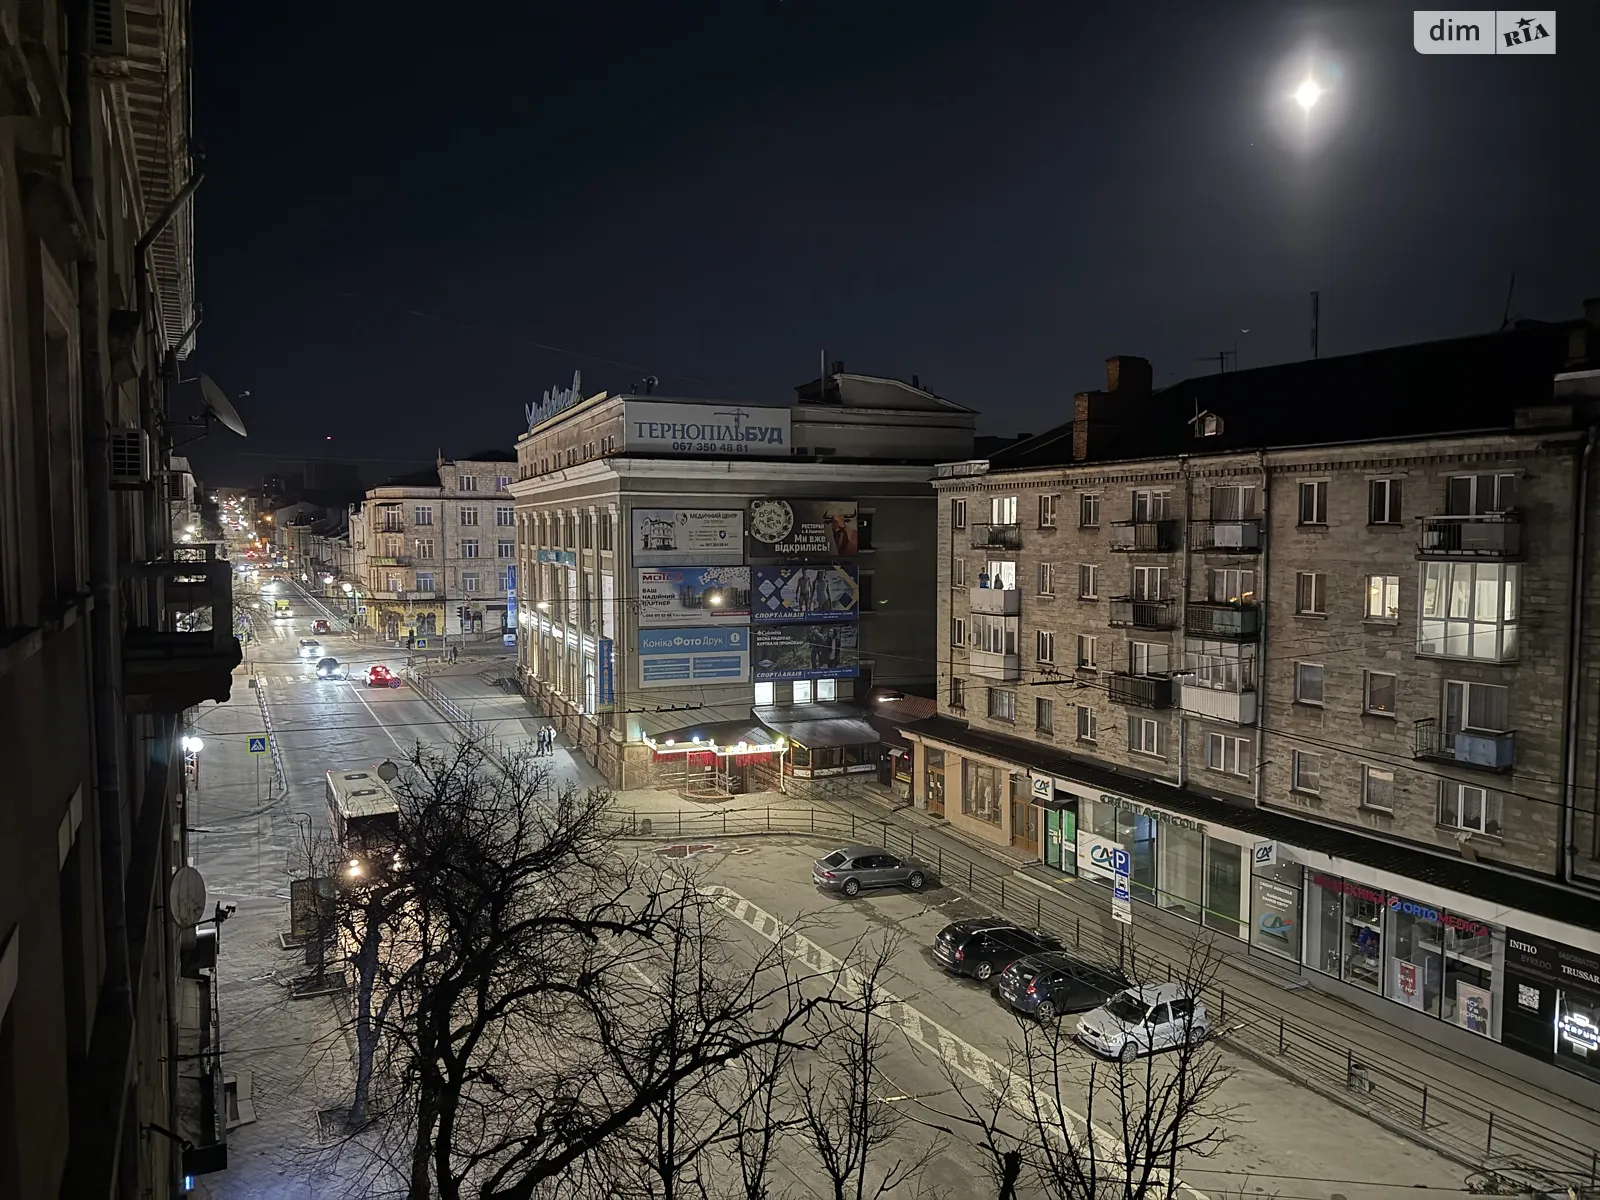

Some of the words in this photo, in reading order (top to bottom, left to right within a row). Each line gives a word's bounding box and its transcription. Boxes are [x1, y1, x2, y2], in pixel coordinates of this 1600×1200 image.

[672, 442, 692, 451] 067
[696, 442, 717, 452] 350
[720, 443, 733, 452] 48
[736, 443, 748, 453] 81
[794, 534, 807, 543] Ми
[774, 542, 830, 553] відкрились!
[643, 639, 673, 648] Коніка
[673, 636, 701, 646] Фото
[702, 636, 723, 646] Друк
[1142, 807, 1209, 834] AGRICOLE
[1115, 851, 1126, 869] P
[1402, 902, 1489, 937] ORTOMEDICA
[1509, 939, 1538, 955] INITIO
[1520, 954, 1552, 970] BYREDO
[1560, 965, 1600, 985] TRUSSAR
